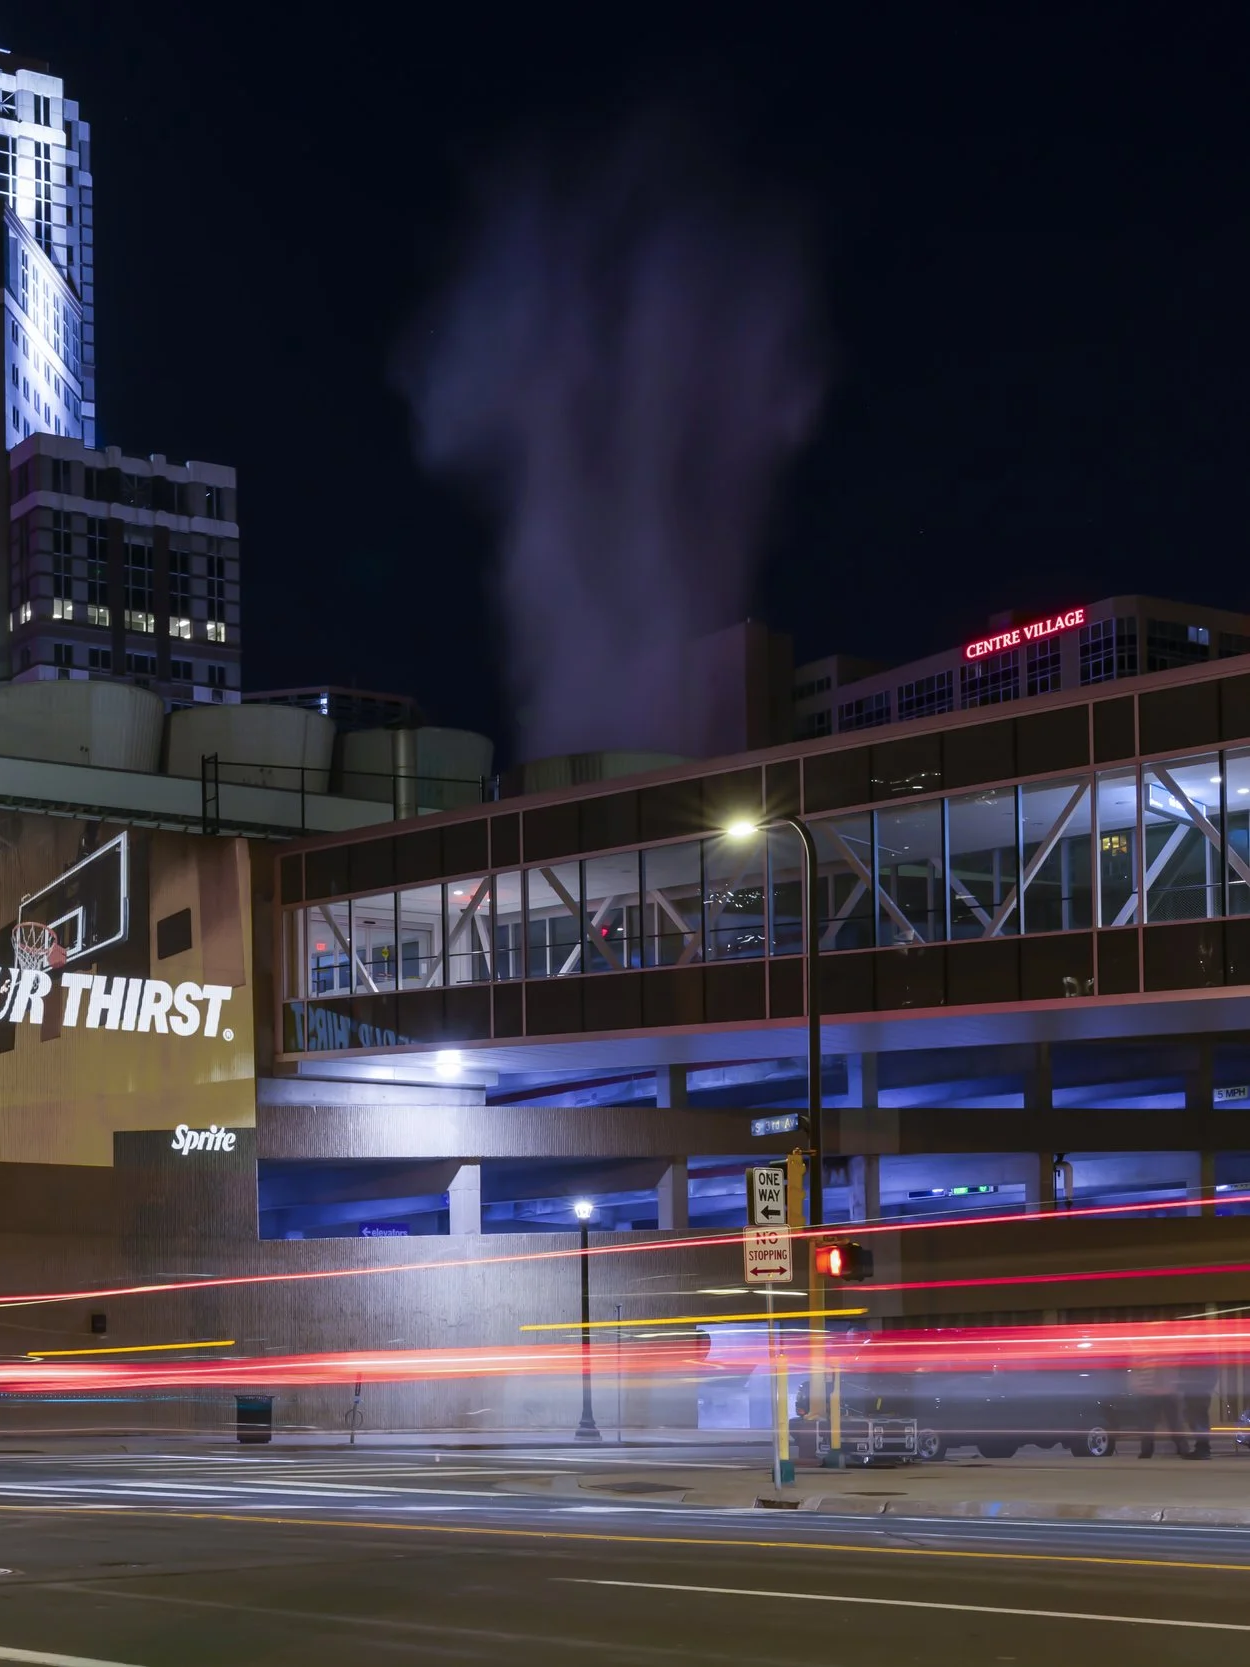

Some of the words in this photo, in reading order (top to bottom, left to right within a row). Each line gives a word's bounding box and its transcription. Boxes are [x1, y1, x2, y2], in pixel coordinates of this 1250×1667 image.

[966, 630, 1020, 658] CENTRE
[1023, 609, 1084, 639] VILLAGE
[1217, 1090, 1224, 1098] 5
[1225, 1088, 1245, 1098] MPH
[755, 1122, 761, 1133] S
[765, 1120, 780, 1131] 3rd
[171, 1124, 236, 1156] Sprite
[758, 1172, 780, 1186] ONE
[758, 1188, 781, 1202] WAY
[756, 1231, 778, 1245] NO
[748, 1249, 788, 1261] STOPPING
